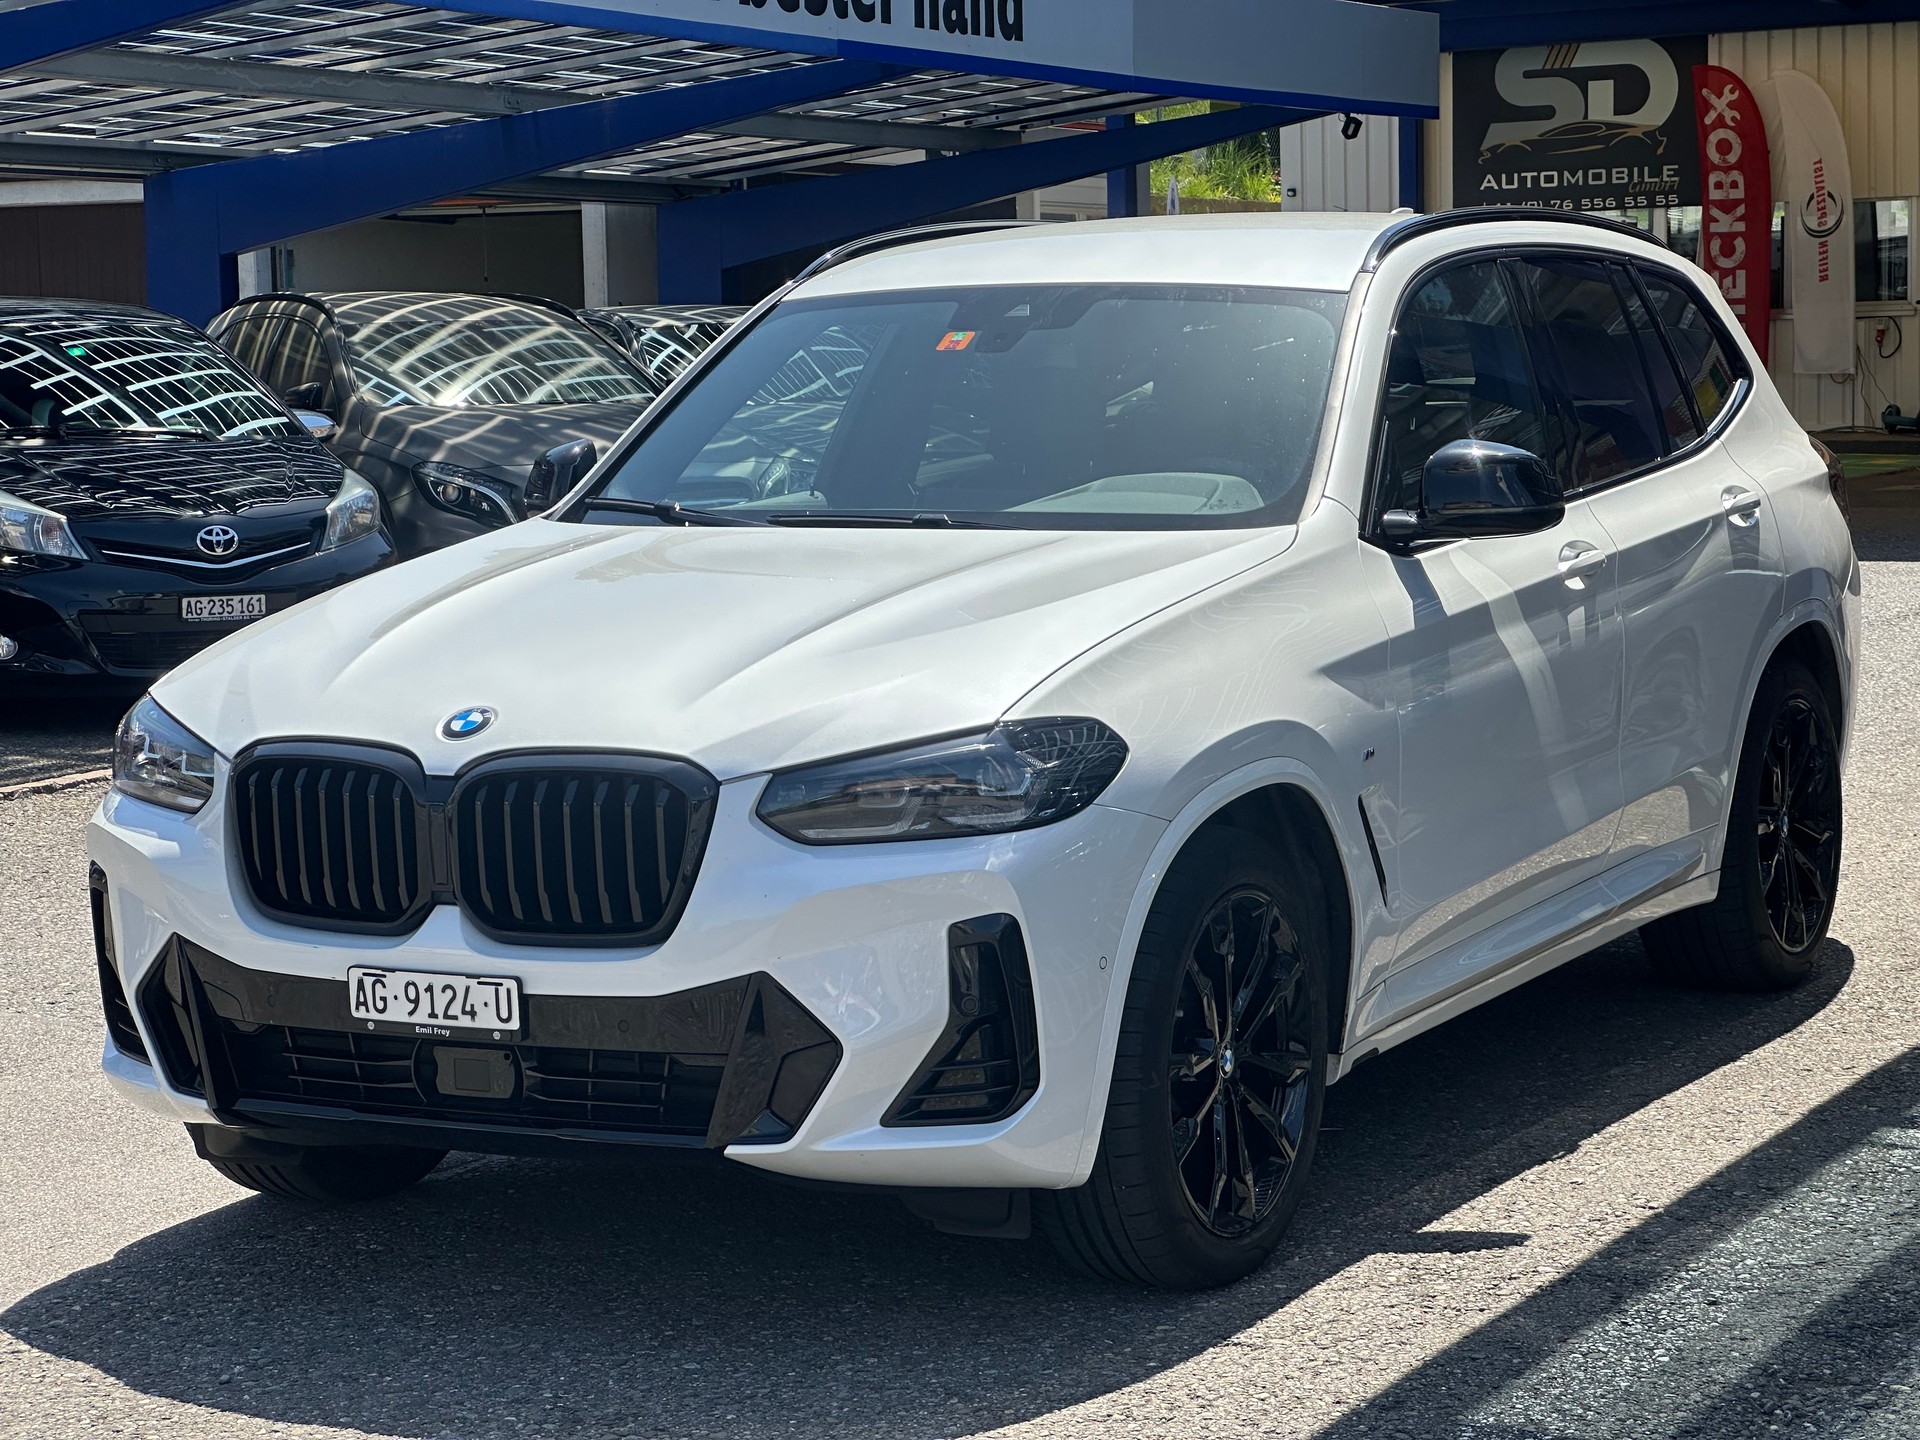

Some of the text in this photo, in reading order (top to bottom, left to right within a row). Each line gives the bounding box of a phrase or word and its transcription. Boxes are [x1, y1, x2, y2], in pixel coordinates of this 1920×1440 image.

[1481, 38, 1679, 150] SD
[1480, 165, 1679, 190] AUTOMOBILE
[1628, 176, 1680, 193] GmbH
[1550, 199, 1573, 210] 76
[1581, 197, 1616, 209] 556
[1624, 196, 1647, 207] 55
[1656, 194, 1679, 205] 55
[1702, 84, 1746, 330] ECKBOX
[415, 1025, 450, 1037] Emil Frey
